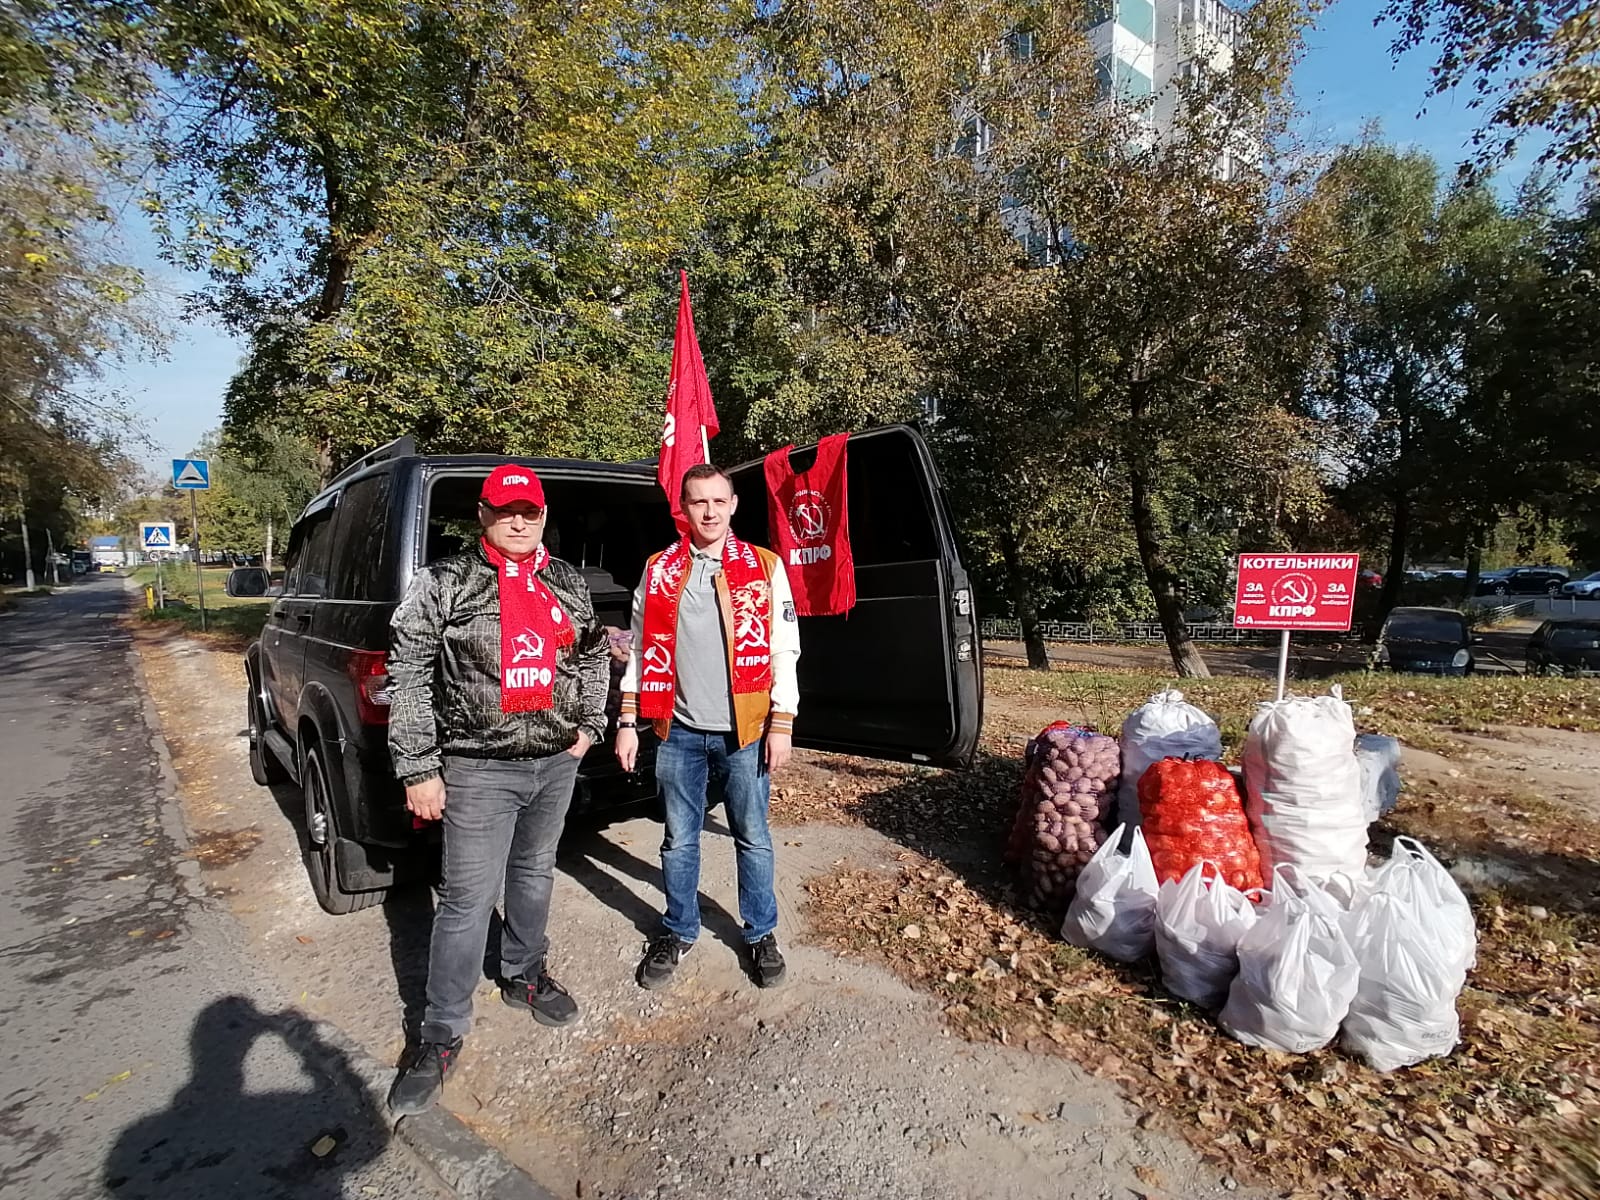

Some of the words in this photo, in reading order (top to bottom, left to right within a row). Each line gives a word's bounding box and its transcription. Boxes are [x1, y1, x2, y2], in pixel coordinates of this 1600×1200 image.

[502, 475, 529, 486] КПРФ
[789, 544, 832, 566] КПРФ
[1243, 558, 1354, 569] КОТЕЛЬНИКИ
[1246, 582, 1264, 592] ЗА
[1328, 583, 1346, 593] ЗА
[1269, 605, 1316, 617] КПРФ
[1236, 615, 1254, 625] ЗА
[736, 655, 769, 667] КПРФ
[505, 667, 552, 688] КПРФ
[642, 681, 673, 692] КПРФ
